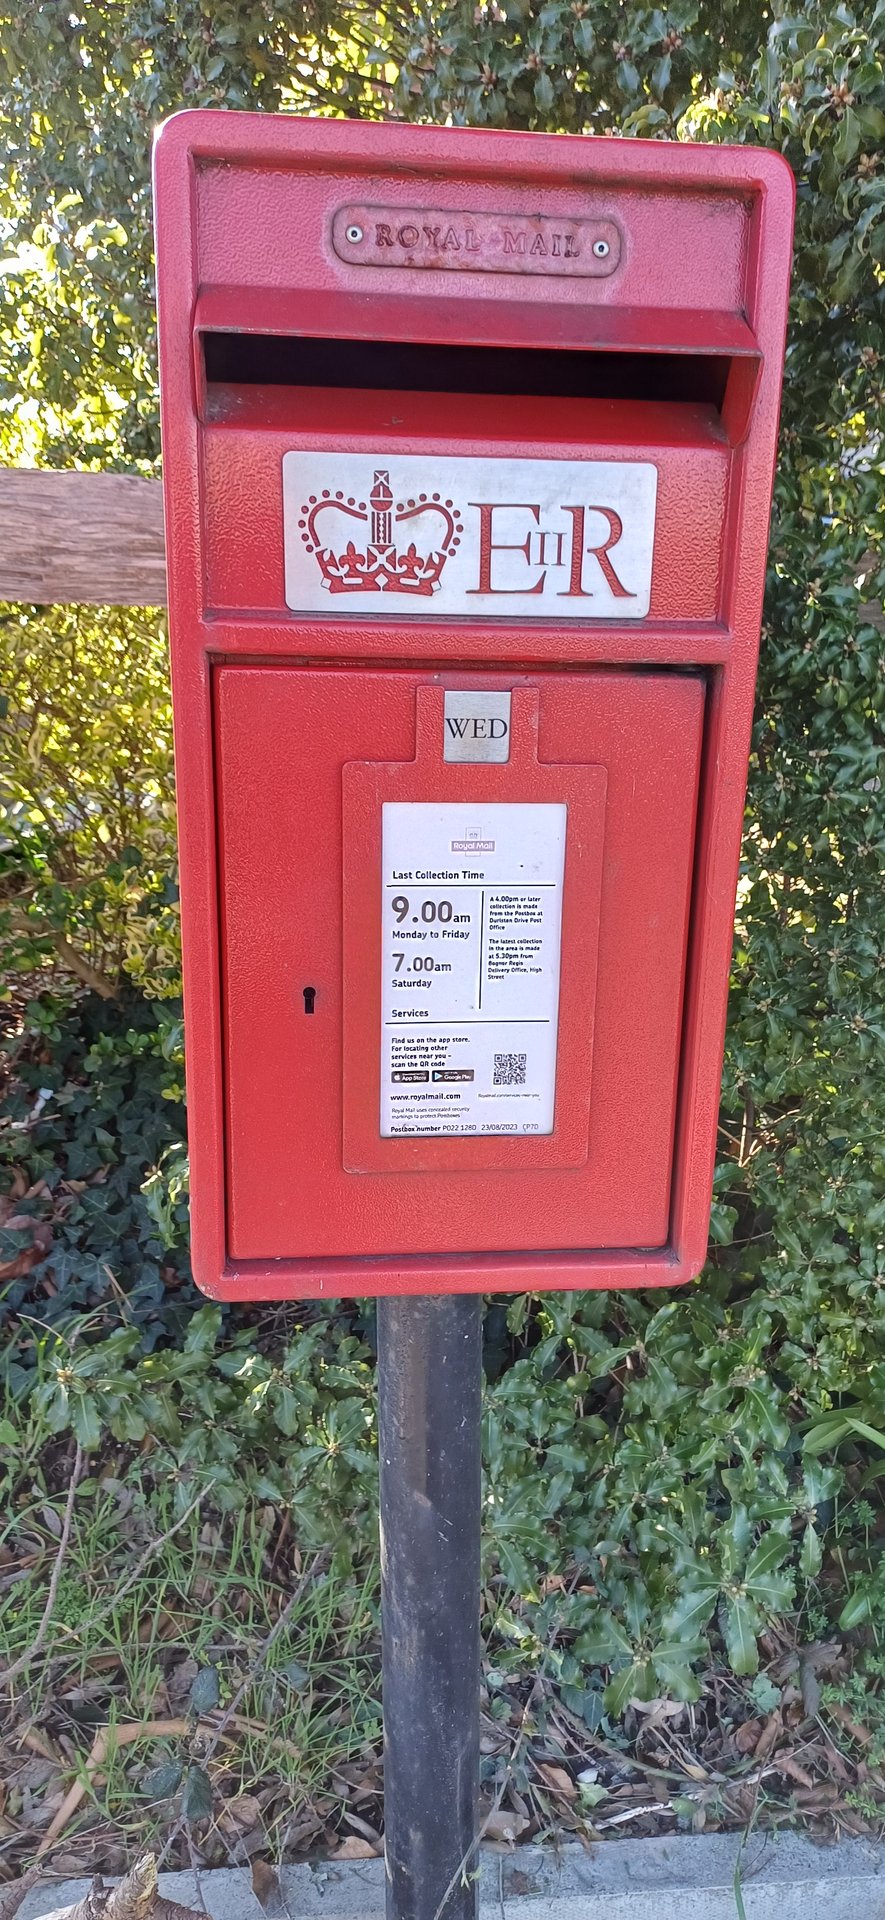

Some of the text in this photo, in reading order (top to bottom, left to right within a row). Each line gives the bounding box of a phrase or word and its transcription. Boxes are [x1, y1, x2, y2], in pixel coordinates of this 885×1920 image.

[375, 223, 580, 258] ROYAL MAIL
[445, 718, 508, 739] WED
[454, 842, 493, 850] Royal Mail
[392, 871, 484, 879] Last Collection Time
[391, 896, 470, 923] 9.00am
[392, 931, 427, 940] Monday
[442, 930, 469, 939] Friday
[392, 953, 451, 972] 7.00am
[392, 979, 432, 988] Saturday
[392, 1009, 428, 1017] Services
[390, 1093, 461, 1101] www.royalmail.com
[391, 1125, 414, 1133] Postbox
